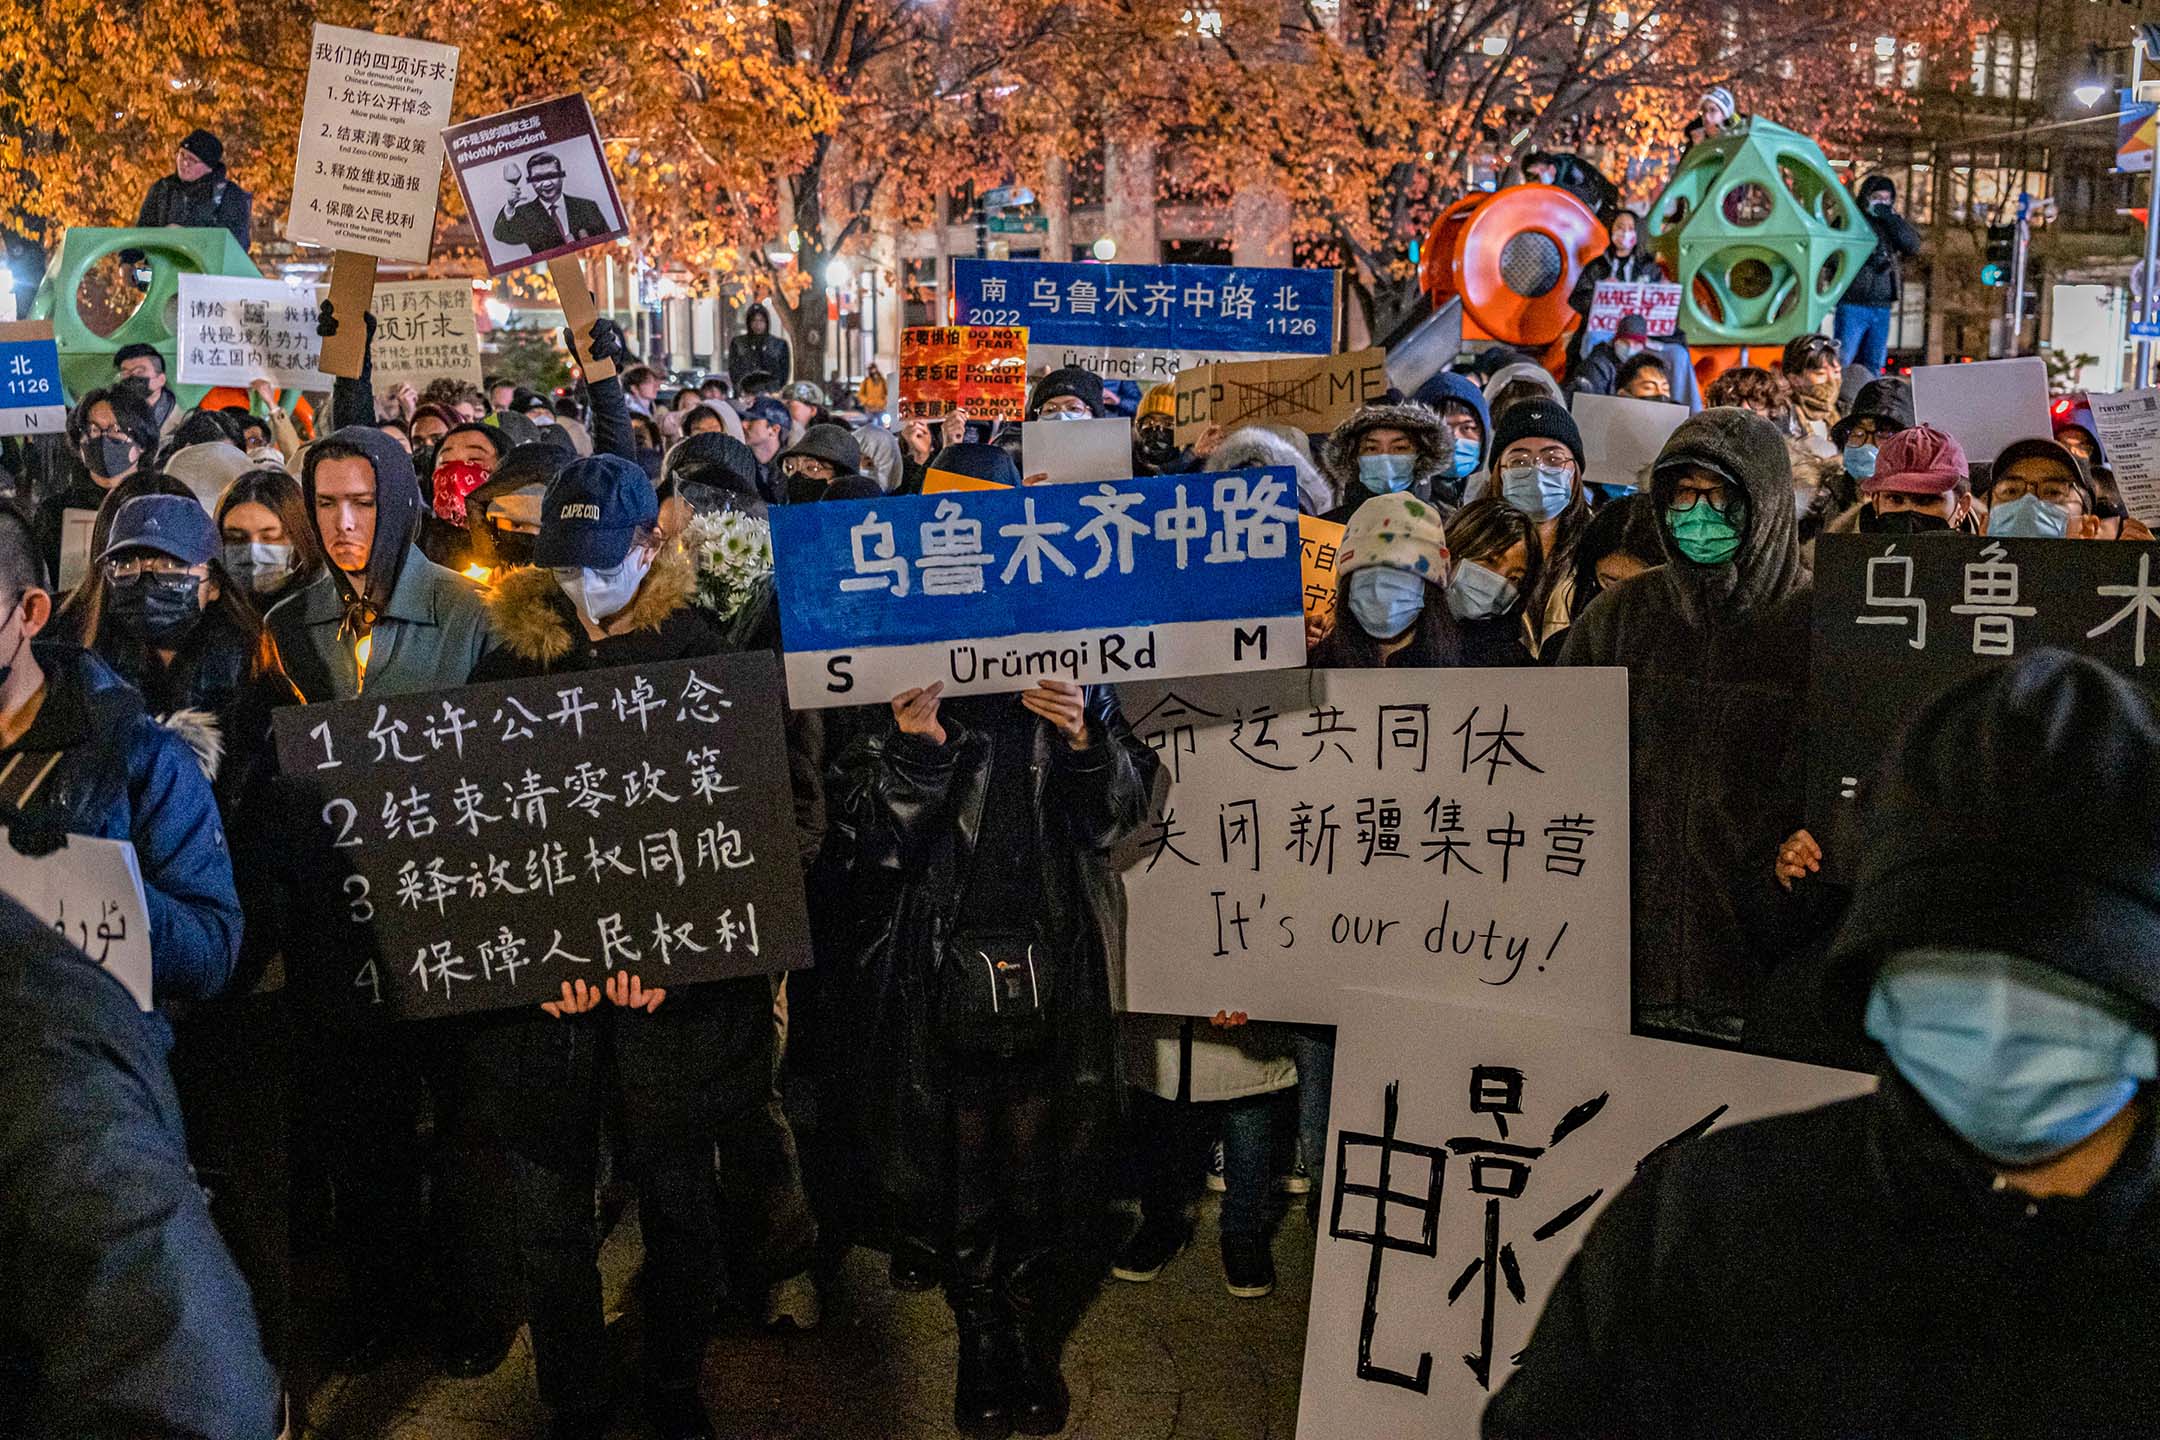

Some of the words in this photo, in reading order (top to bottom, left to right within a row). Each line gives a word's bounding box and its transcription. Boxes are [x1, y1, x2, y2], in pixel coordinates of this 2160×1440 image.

[327, 86, 338, 100] 1.
[341, 87, 432, 116] 允许公开悼念
[320, 123, 332, 138] 2.
[337, 125, 426, 155] 结束清零政策
[457, 130, 547, 164] #NotMyPresident
[315, 160, 327, 175] 3.
[331, 162, 420, 192] 释放维权通报
[310, 198, 321, 213] 4.
[326, 200, 415, 230] 保障公民权利
[981, 278, 1007, 303] 南
[1028, 277, 1257, 320] 乌鲁木齐中路
[1273, 286, 1300, 312] 北
[1641, 288, 1680, 306] LOVE
[969, 309, 1022, 326] 2022
[1266, 317, 1317, 336] 1126
[902, 329, 960, 346] 不要惧怕
[969, 331, 988, 339] DO
[993, 331, 1022, 339] NOT
[976, 340, 1013, 349] FEAR
[10, 355, 33, 375] 北
[902, 365, 958, 381] 不要忘记
[967, 365, 987, 373] DO
[991, 366, 1021, 374] NOT
[1063, 350, 1137, 377] Ürümqi
[1152, 356, 1181, 376] Rd
[8, 379, 50, 394] 1126
[965, 376, 1022, 384] FORGET
[965, 398, 985, 406] DO
[990, 398, 1018, 406] NOT
[1176, 384, 1225, 427] CCP
[1329, 364, 1383, 405] ME
[25, 413, 38, 428] N
[966, 408, 1022, 416] ORGVE
[561, 503, 584, 519] CAPE
[583, 504, 600, 520] COD
[839, 475, 1299, 597] 乌鲁木齐中路
[826, 655, 854, 694] S
[949, 640, 1088, 686] Ürümqi
[1100, 632, 1157, 675] Rd
[1234, 625, 1268, 662] M
[310, 720, 342, 769] 1
[368, 669, 732, 763] 允许公开悼念
[1131, 692, 1545, 785] 命运共同体
[322, 797, 363, 847] 2
[381, 746, 739, 839] 结束清零政策
[1139, 794, 1596, 883] 关闭新疆集中营
[343, 874, 375, 923] 3
[397, 820, 755, 917] 释放维权同胞
[1211, 891, 1295, 956] It's
[1331, 911, 1400, 946] our
[1424, 900, 1569, 985] duty!
[354, 958, 385, 1003] 4
[409, 903, 760, 1000] 保障人民权利
